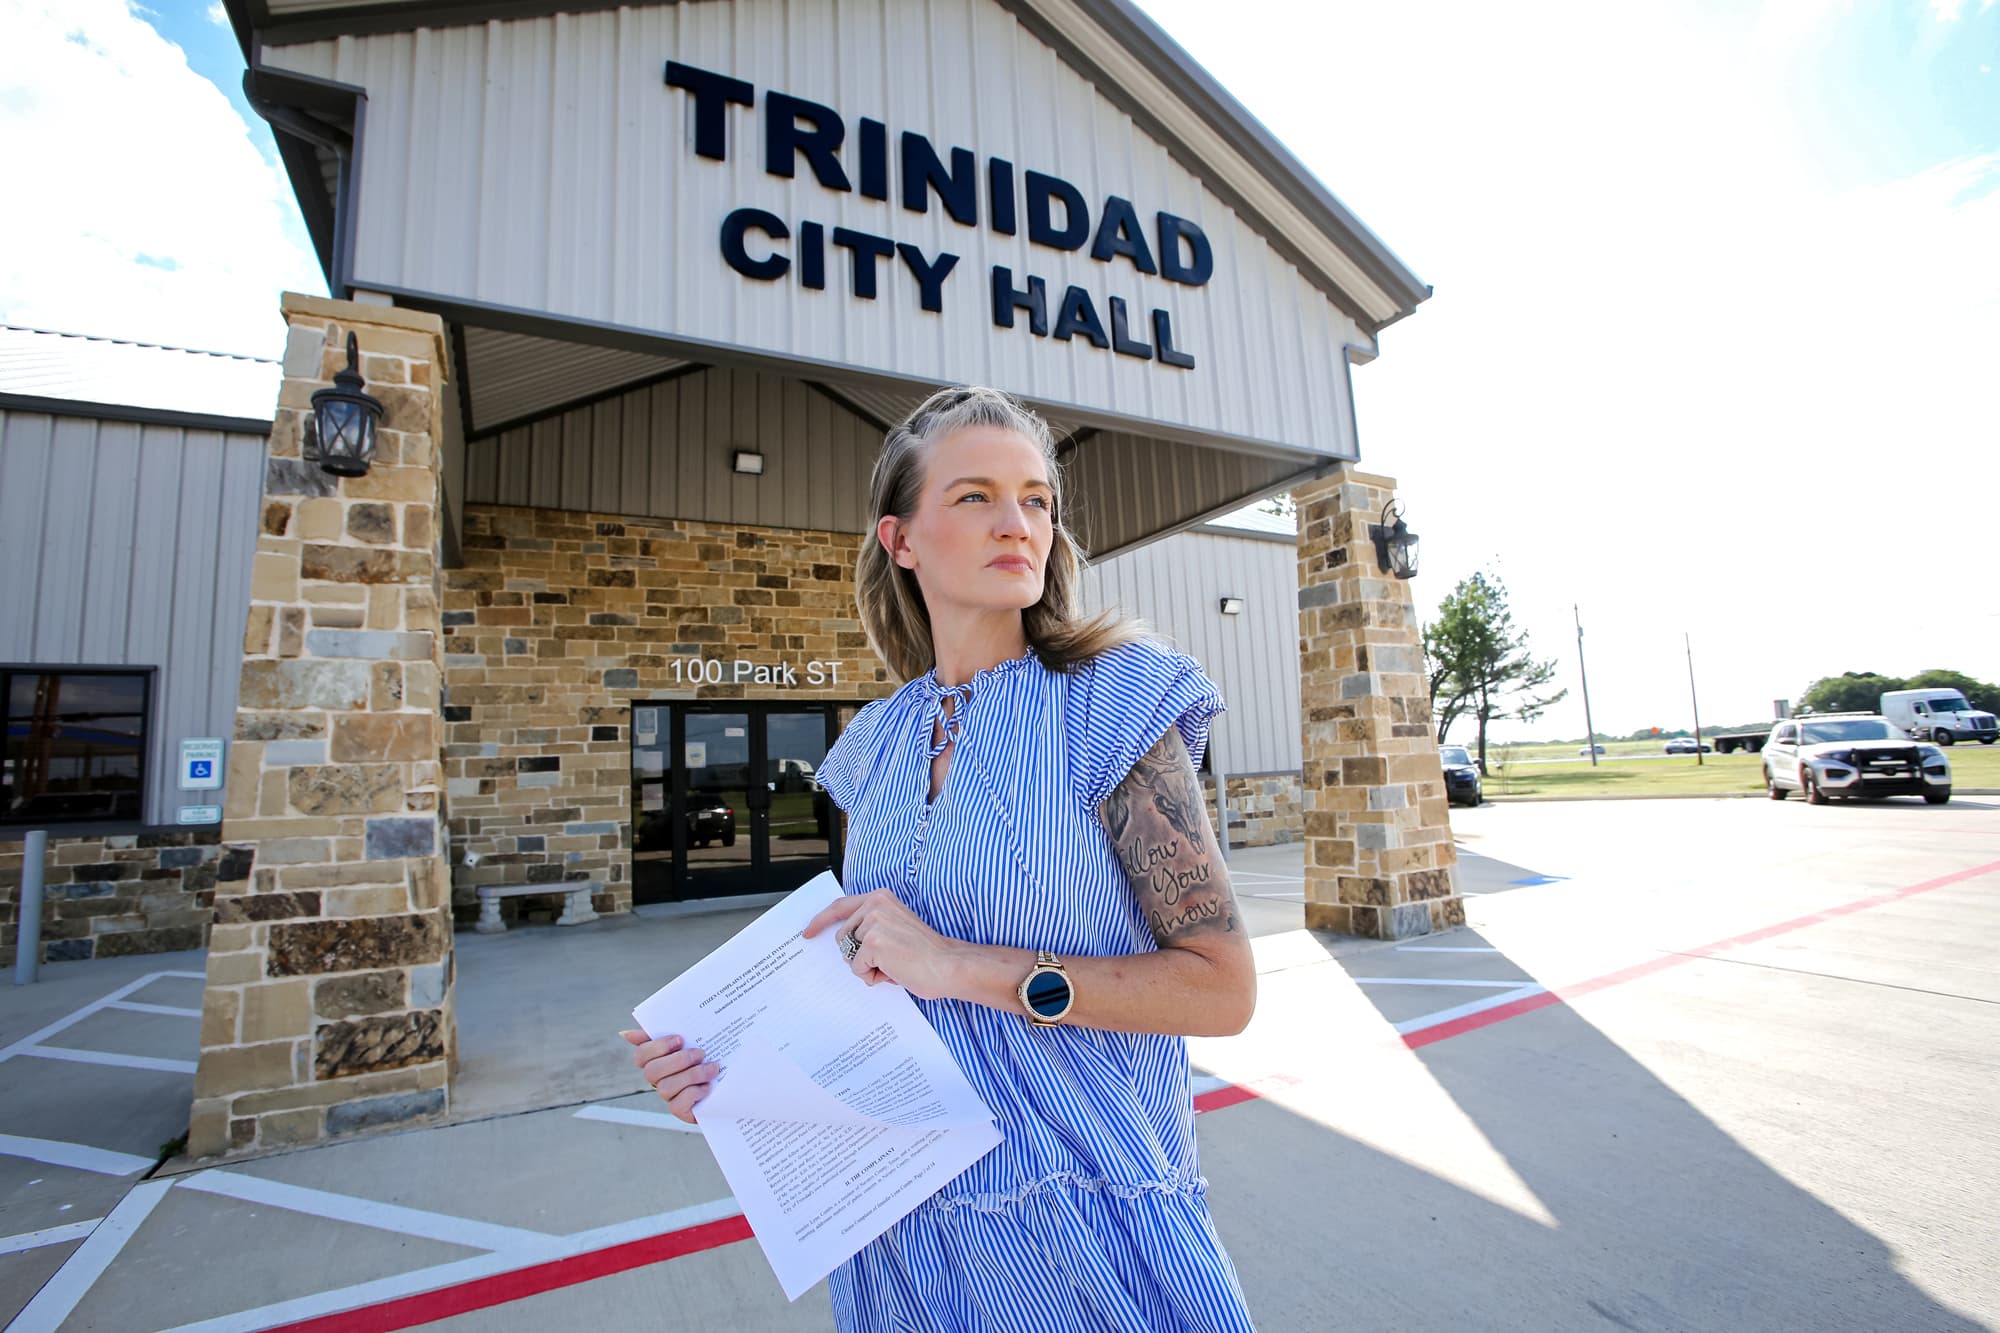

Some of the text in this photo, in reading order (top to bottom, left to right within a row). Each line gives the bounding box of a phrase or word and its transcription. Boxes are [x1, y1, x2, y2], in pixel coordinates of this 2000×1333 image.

[665, 60, 1214, 287] TRINIDAD
[720, 207, 1195, 369] CITY HALL
[670, 658, 842, 685] 100 Park ST
[1119, 837, 1179, 879] ollow
[1153, 863, 1209, 906] Your
[1151, 896, 1219, 936] Arrow
